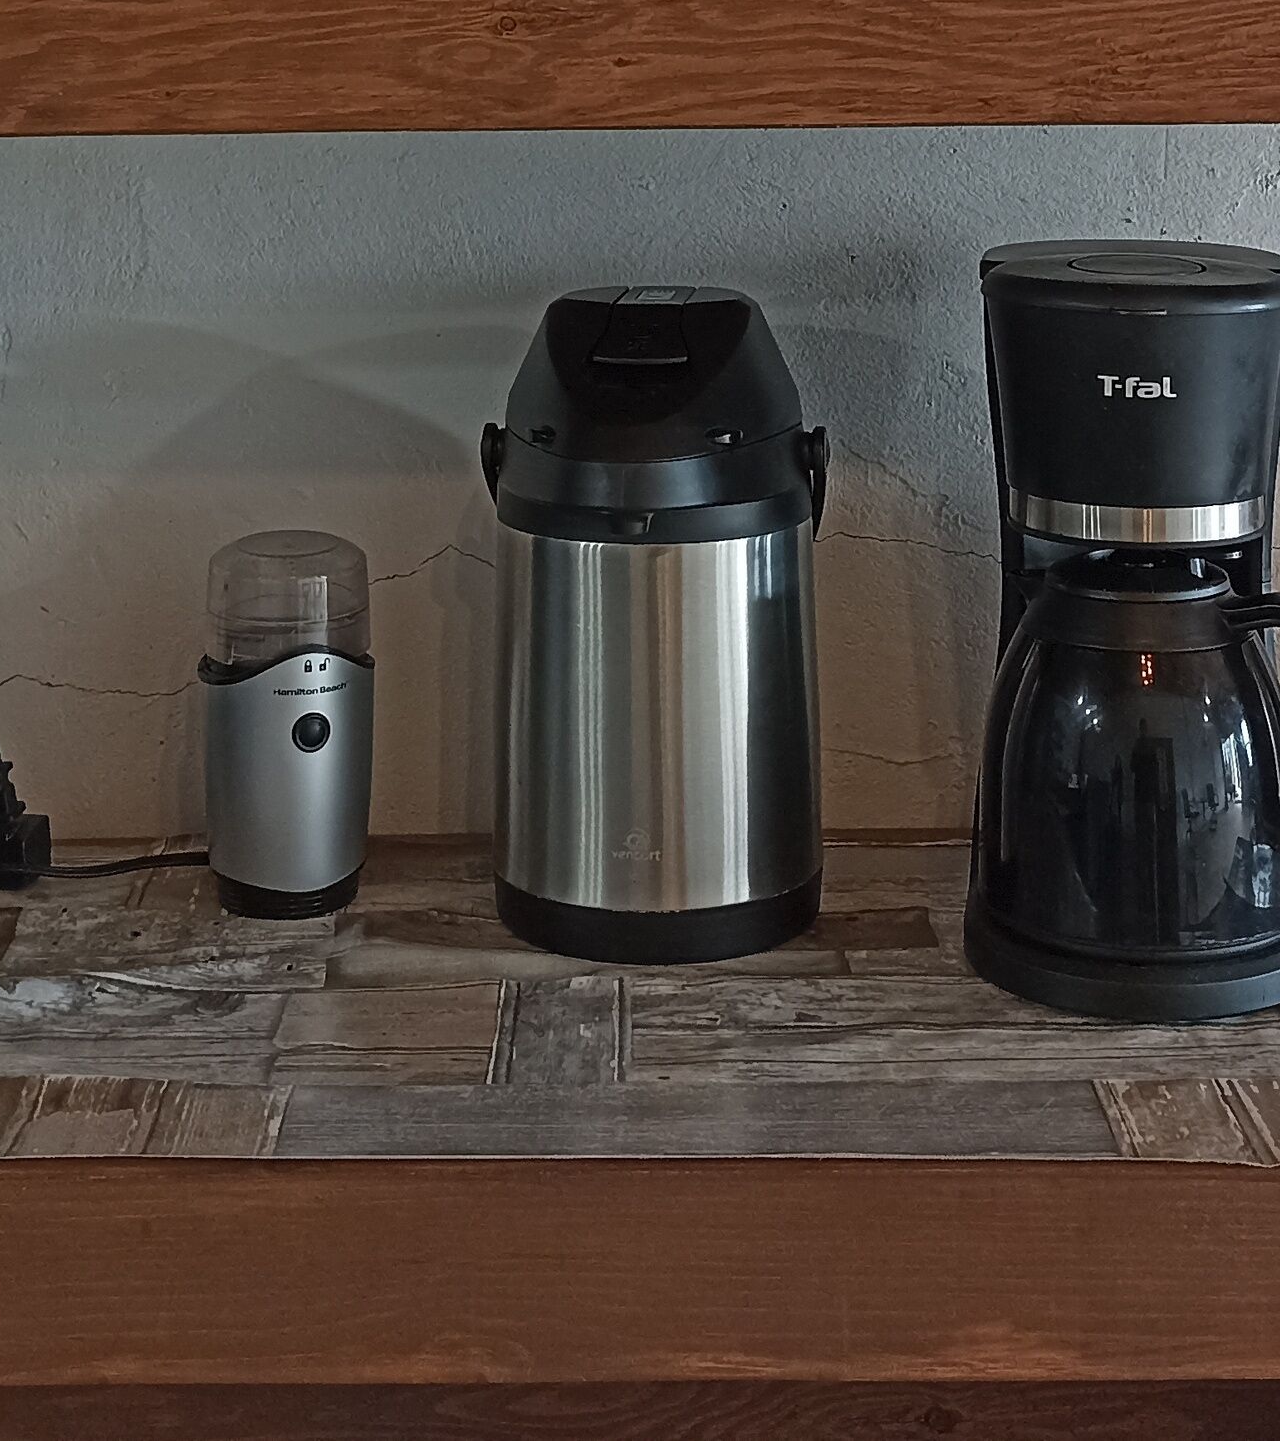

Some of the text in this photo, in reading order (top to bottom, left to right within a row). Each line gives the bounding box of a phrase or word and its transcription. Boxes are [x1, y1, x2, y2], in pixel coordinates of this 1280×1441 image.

[1097, 374, 1178, 399] T-fal
[273, 682, 348, 696] Hamilton Beach
